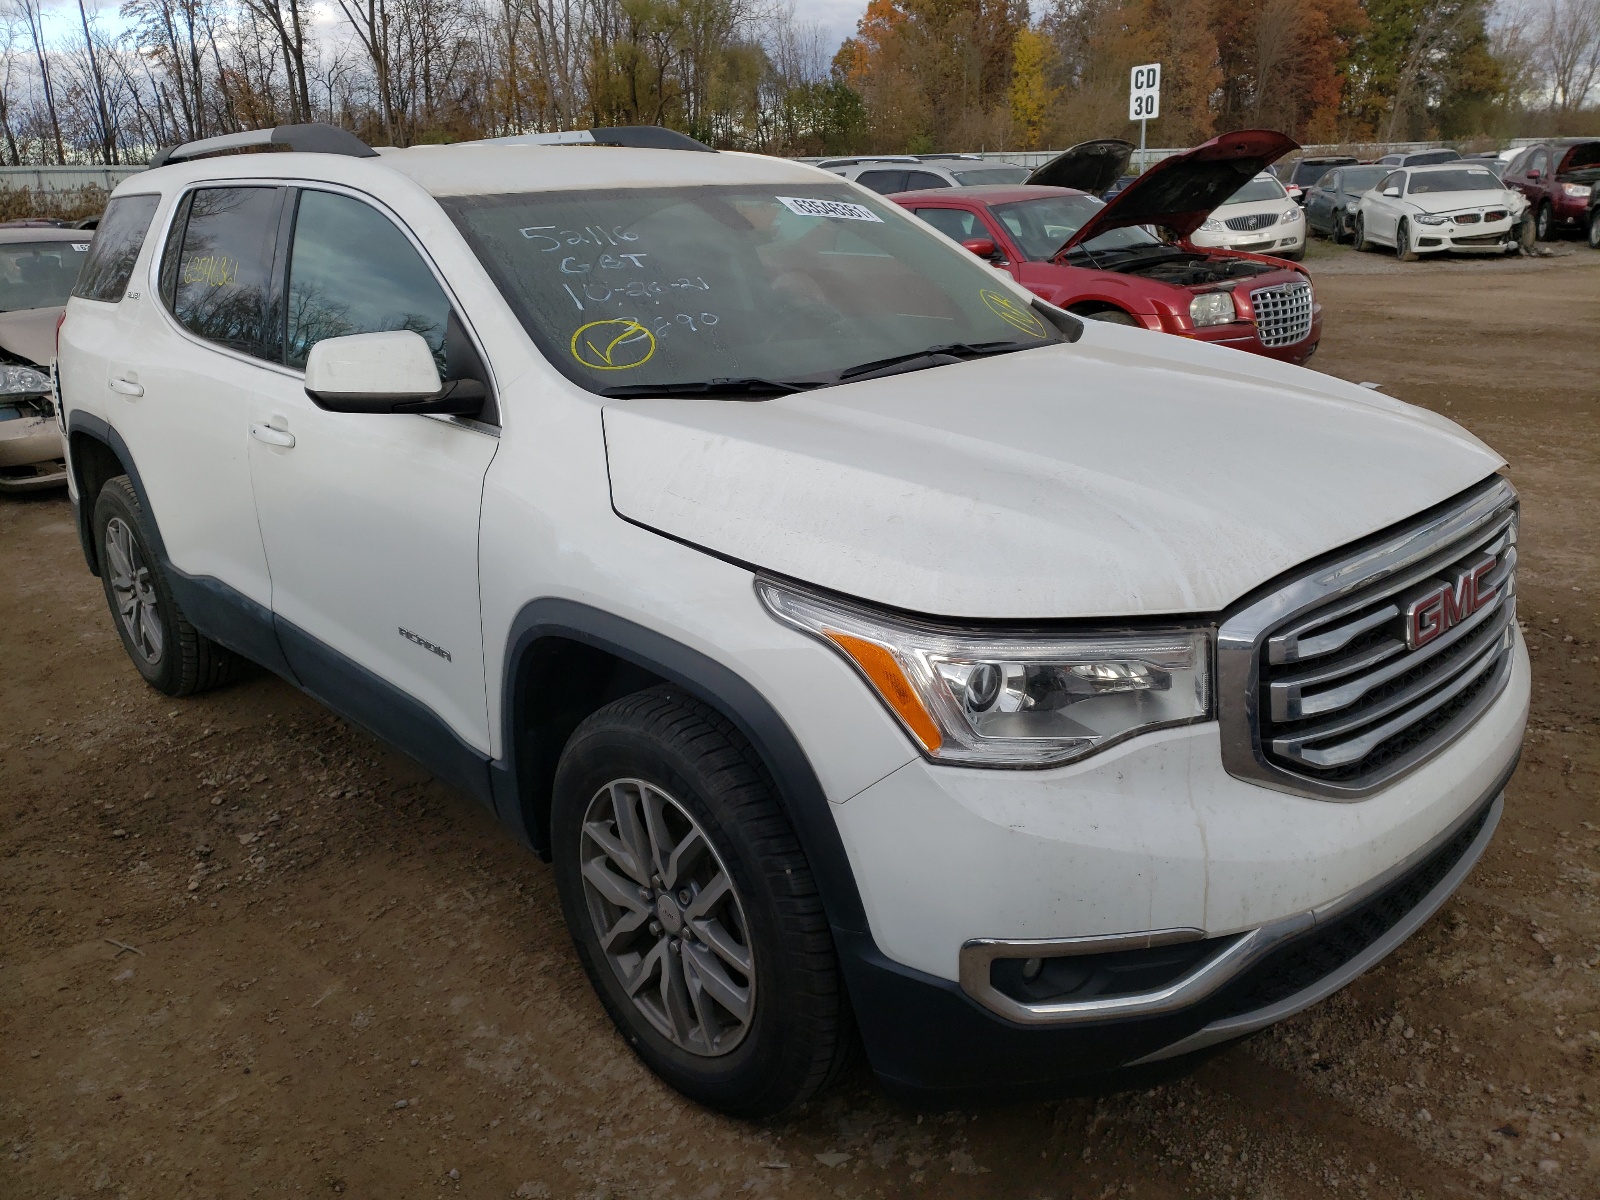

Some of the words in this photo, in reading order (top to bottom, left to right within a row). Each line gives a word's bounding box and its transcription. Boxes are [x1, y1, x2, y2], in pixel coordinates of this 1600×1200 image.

[1134, 67, 1157, 90] CD
[1134, 94, 1154, 116] 30
[792, 199, 870, 219] 63546361
[519, 225, 639, 252] 52116
[1406, 555, 1497, 651] GMC
